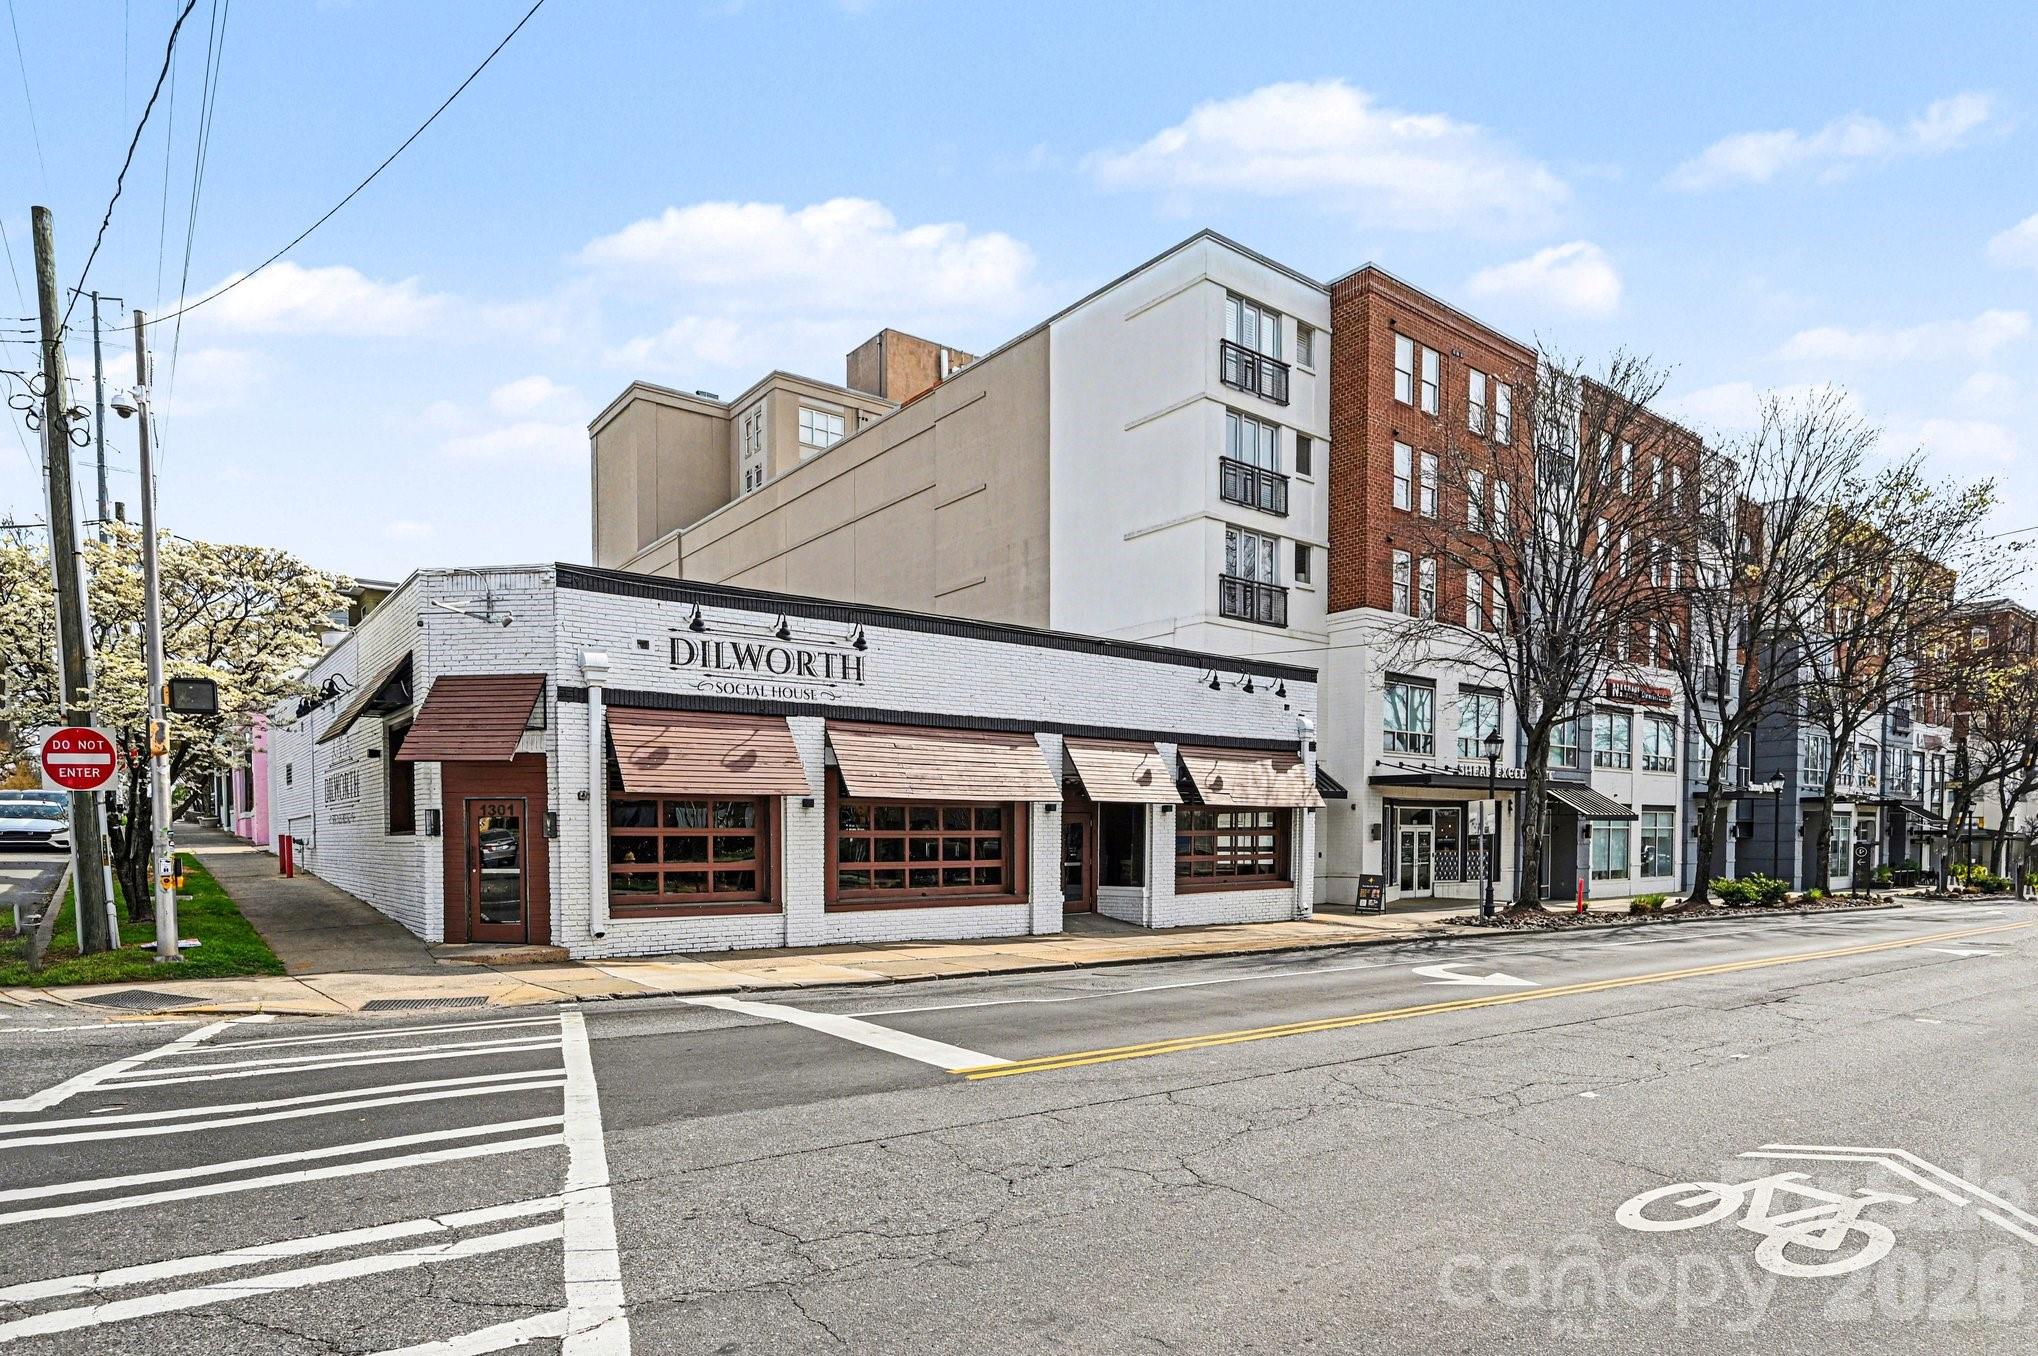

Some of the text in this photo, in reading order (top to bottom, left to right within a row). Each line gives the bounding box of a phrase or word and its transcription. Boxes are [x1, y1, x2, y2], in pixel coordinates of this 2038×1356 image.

[669, 636, 866, 682] DILWORTH
[715, 681, 817, 701] SOCIAL HOUSE
[52, 739, 104, 750] DO NOT
[59, 767, 101, 778] ENTER
[324, 769, 360, 804] DILWORTH
[480, 804, 514, 816] 1301
